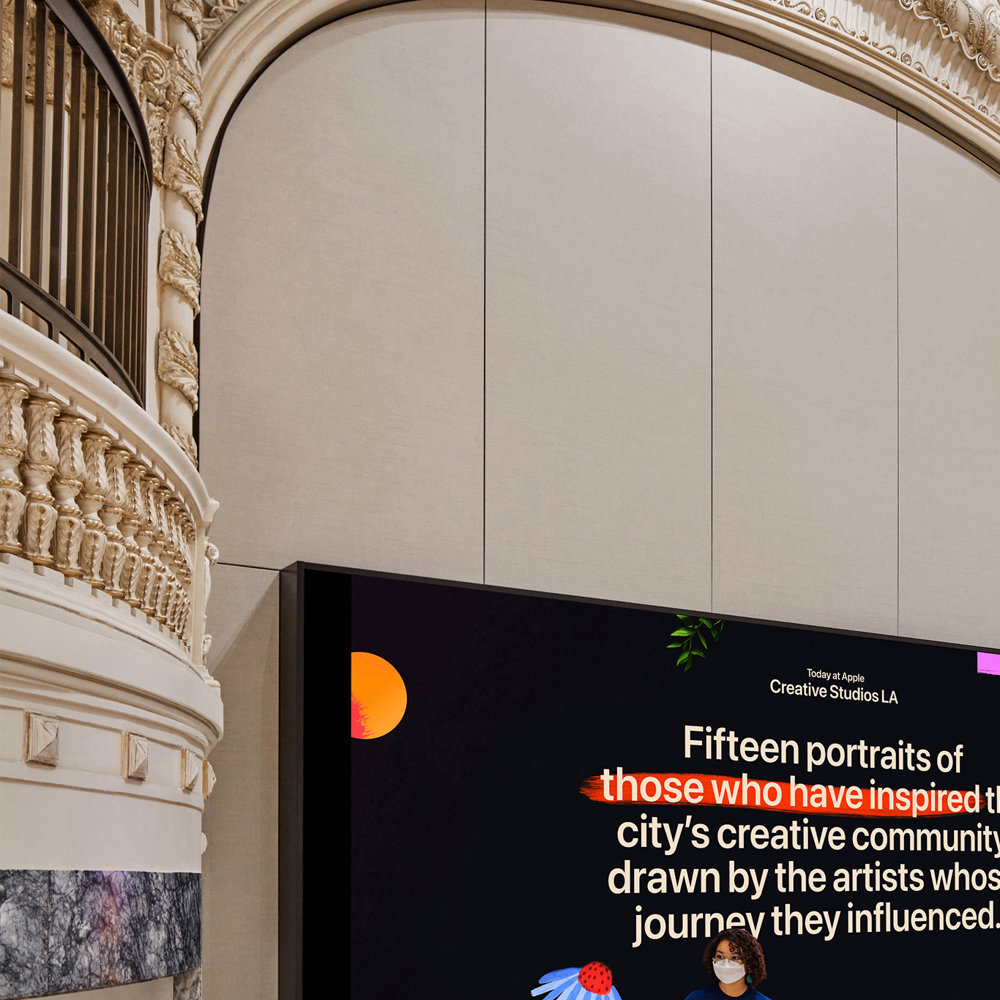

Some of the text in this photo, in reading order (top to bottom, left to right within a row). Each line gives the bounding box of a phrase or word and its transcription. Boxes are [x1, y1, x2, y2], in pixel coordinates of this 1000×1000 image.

[769, 678, 899, 705] Creative Studios LA
[807, 668, 865, 683] Today at Apple
[684, 724, 964, 773] Fifteen portraits of
[600, 766, 704, 804] those
[710, 772, 783, 807] who
[789, 775, 863, 810] have
[869, 778, 981, 818] inspired
[617, 813, 710, 856] city’s
[717, 817, 846, 850] creative
[607, 859, 721, 895] drawn
[728, 860, 769, 901] by
[774, 860, 827, 893] the
[832, 860, 925, 892] artists
[632, 904, 765, 949] journey
[770, 901, 842, 942] they
